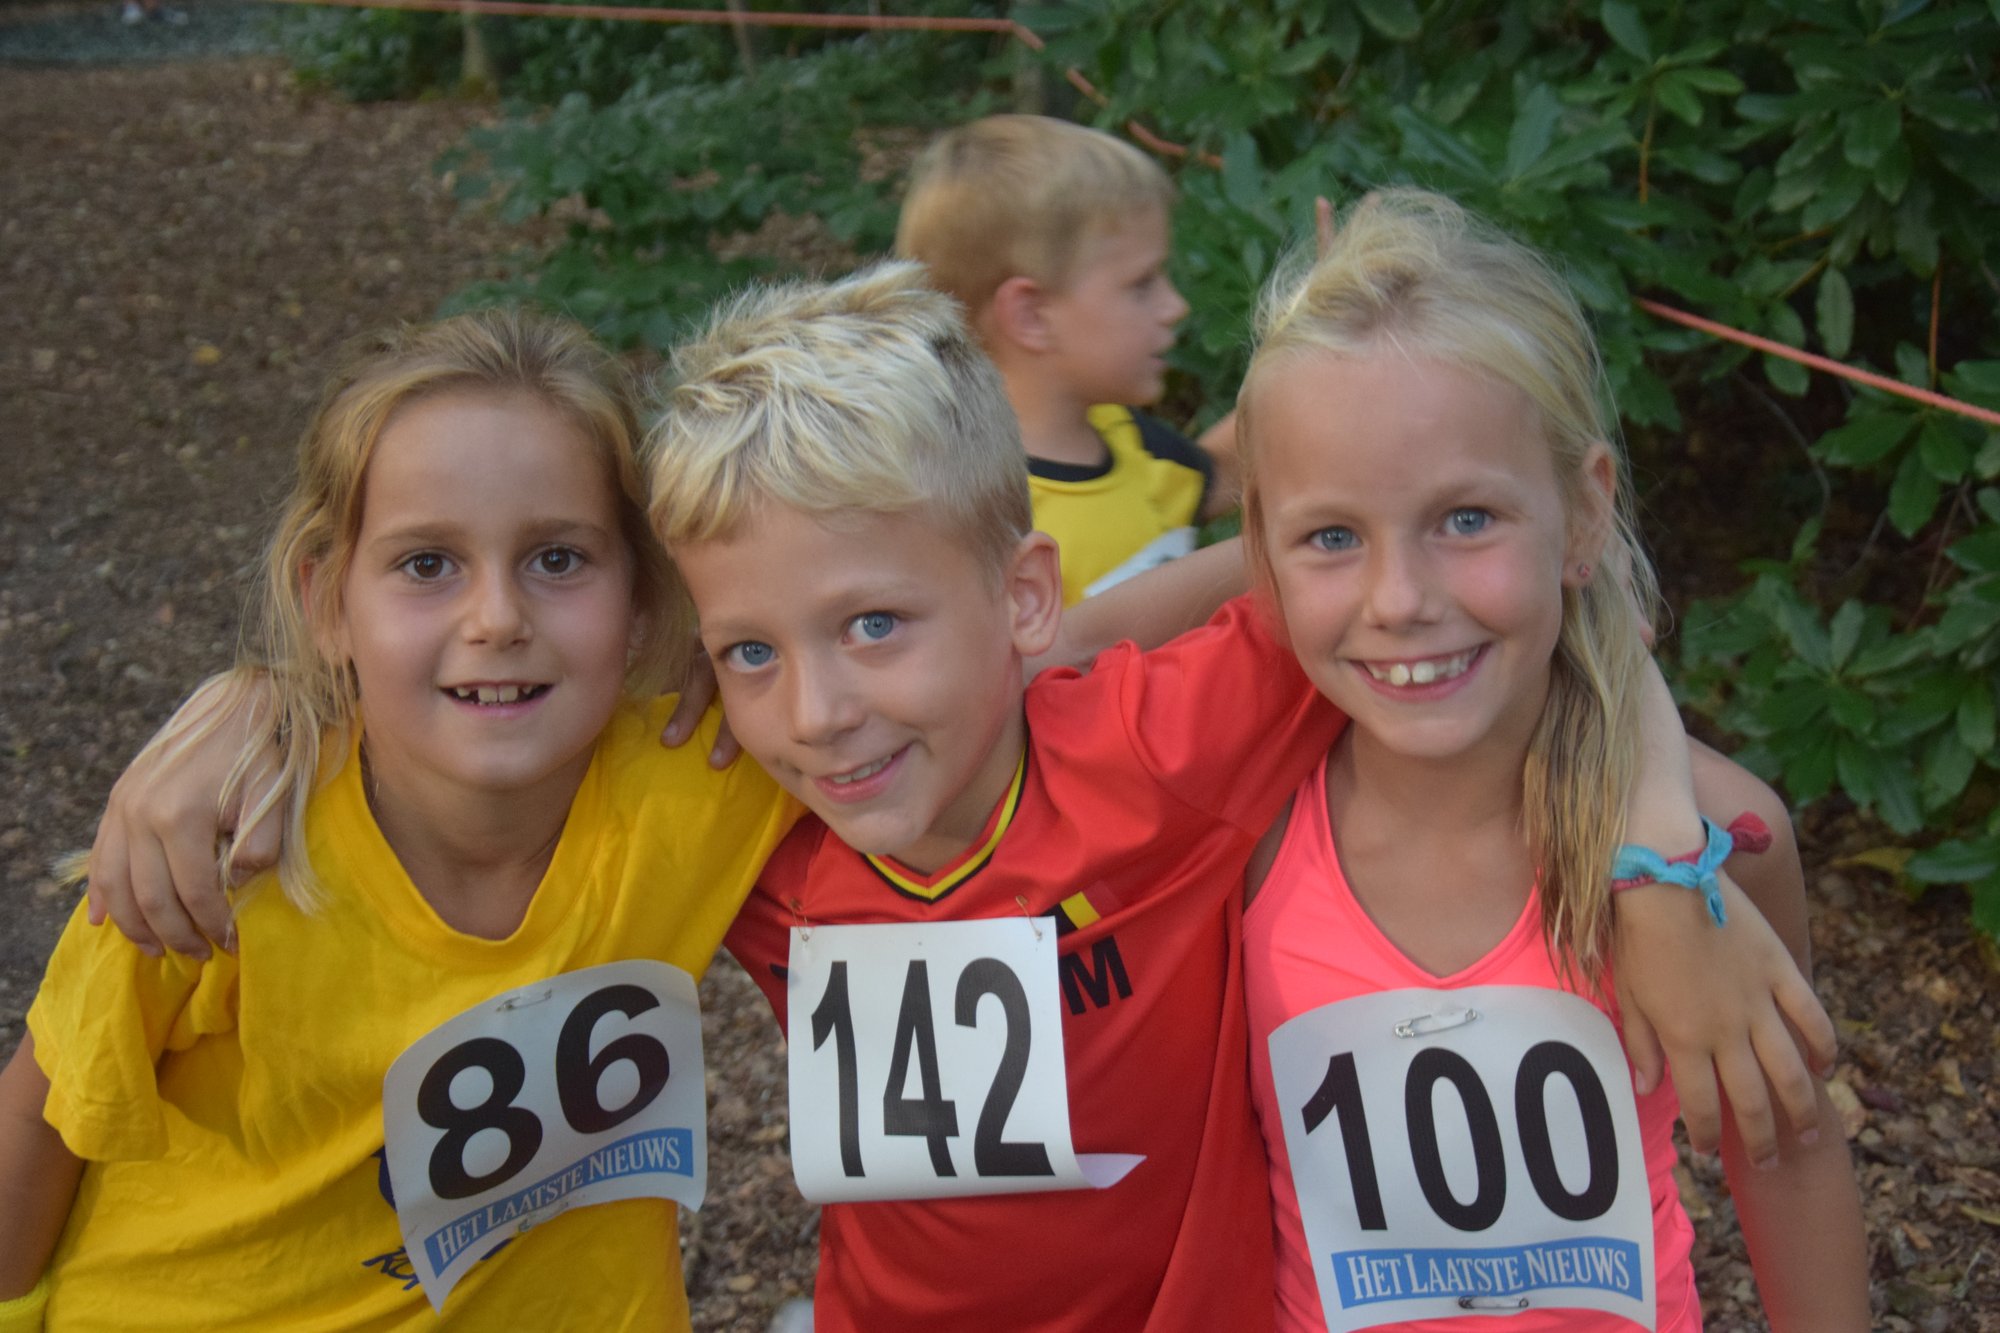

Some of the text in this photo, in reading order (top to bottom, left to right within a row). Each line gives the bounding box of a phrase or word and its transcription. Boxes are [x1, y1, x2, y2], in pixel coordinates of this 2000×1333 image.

[417, 983, 670, 1201] 86
[811, 956, 1056, 1178] 142
[1301, 1040, 1620, 1233] 100
[435, 1136, 681, 1265] HET LAATSTE NIEUWS
[1346, 1246, 1631, 1300] HET LAATSTE NIEUWS
